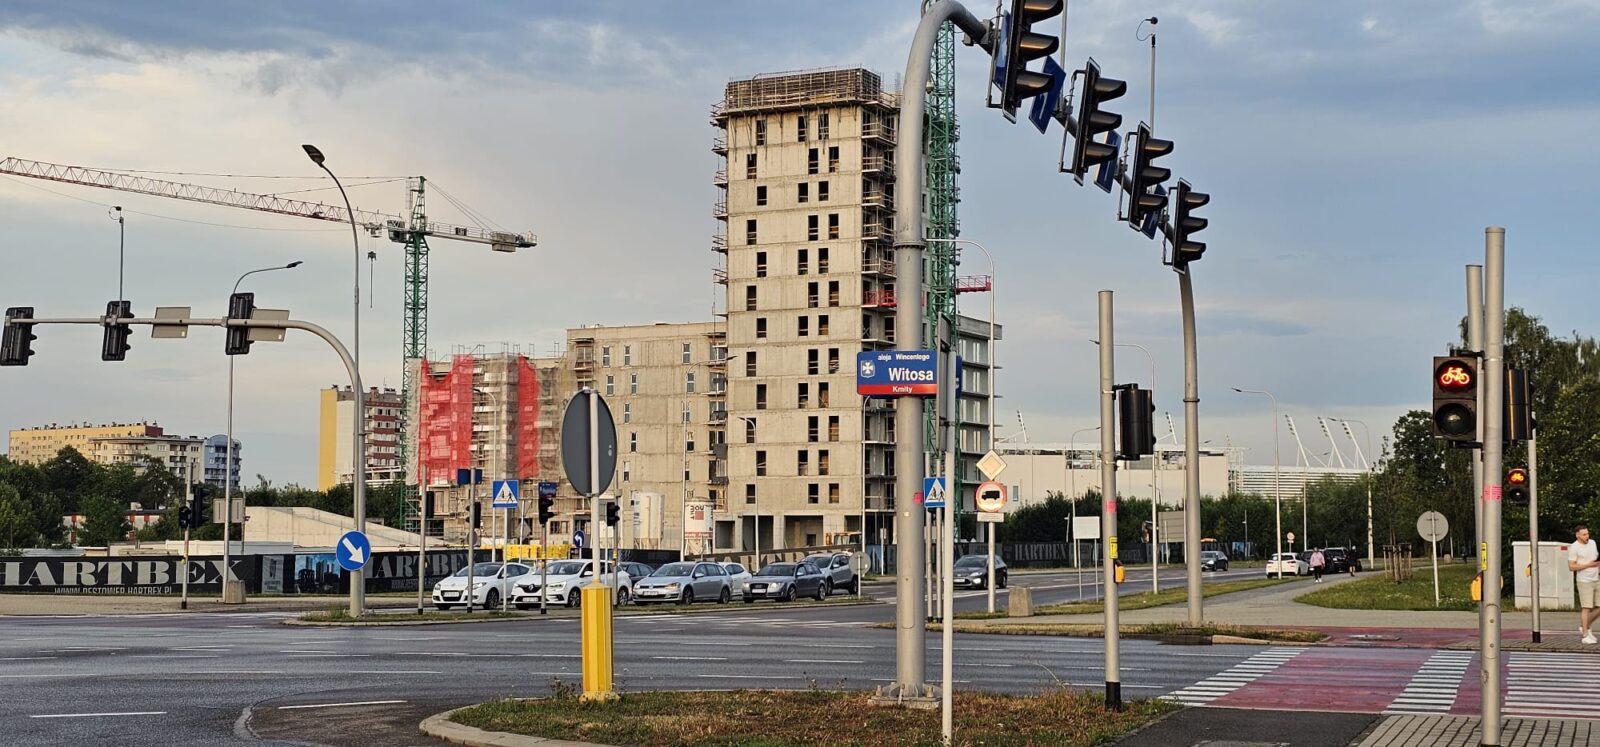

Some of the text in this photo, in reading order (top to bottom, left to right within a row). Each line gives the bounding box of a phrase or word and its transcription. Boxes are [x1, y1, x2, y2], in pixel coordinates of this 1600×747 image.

[877, 353, 930, 362] aleja Wincentego
[888, 367, 934, 382] Witosa
[892, 386, 913, 394] Kmity
[364, 553, 477, 580] ARBE
